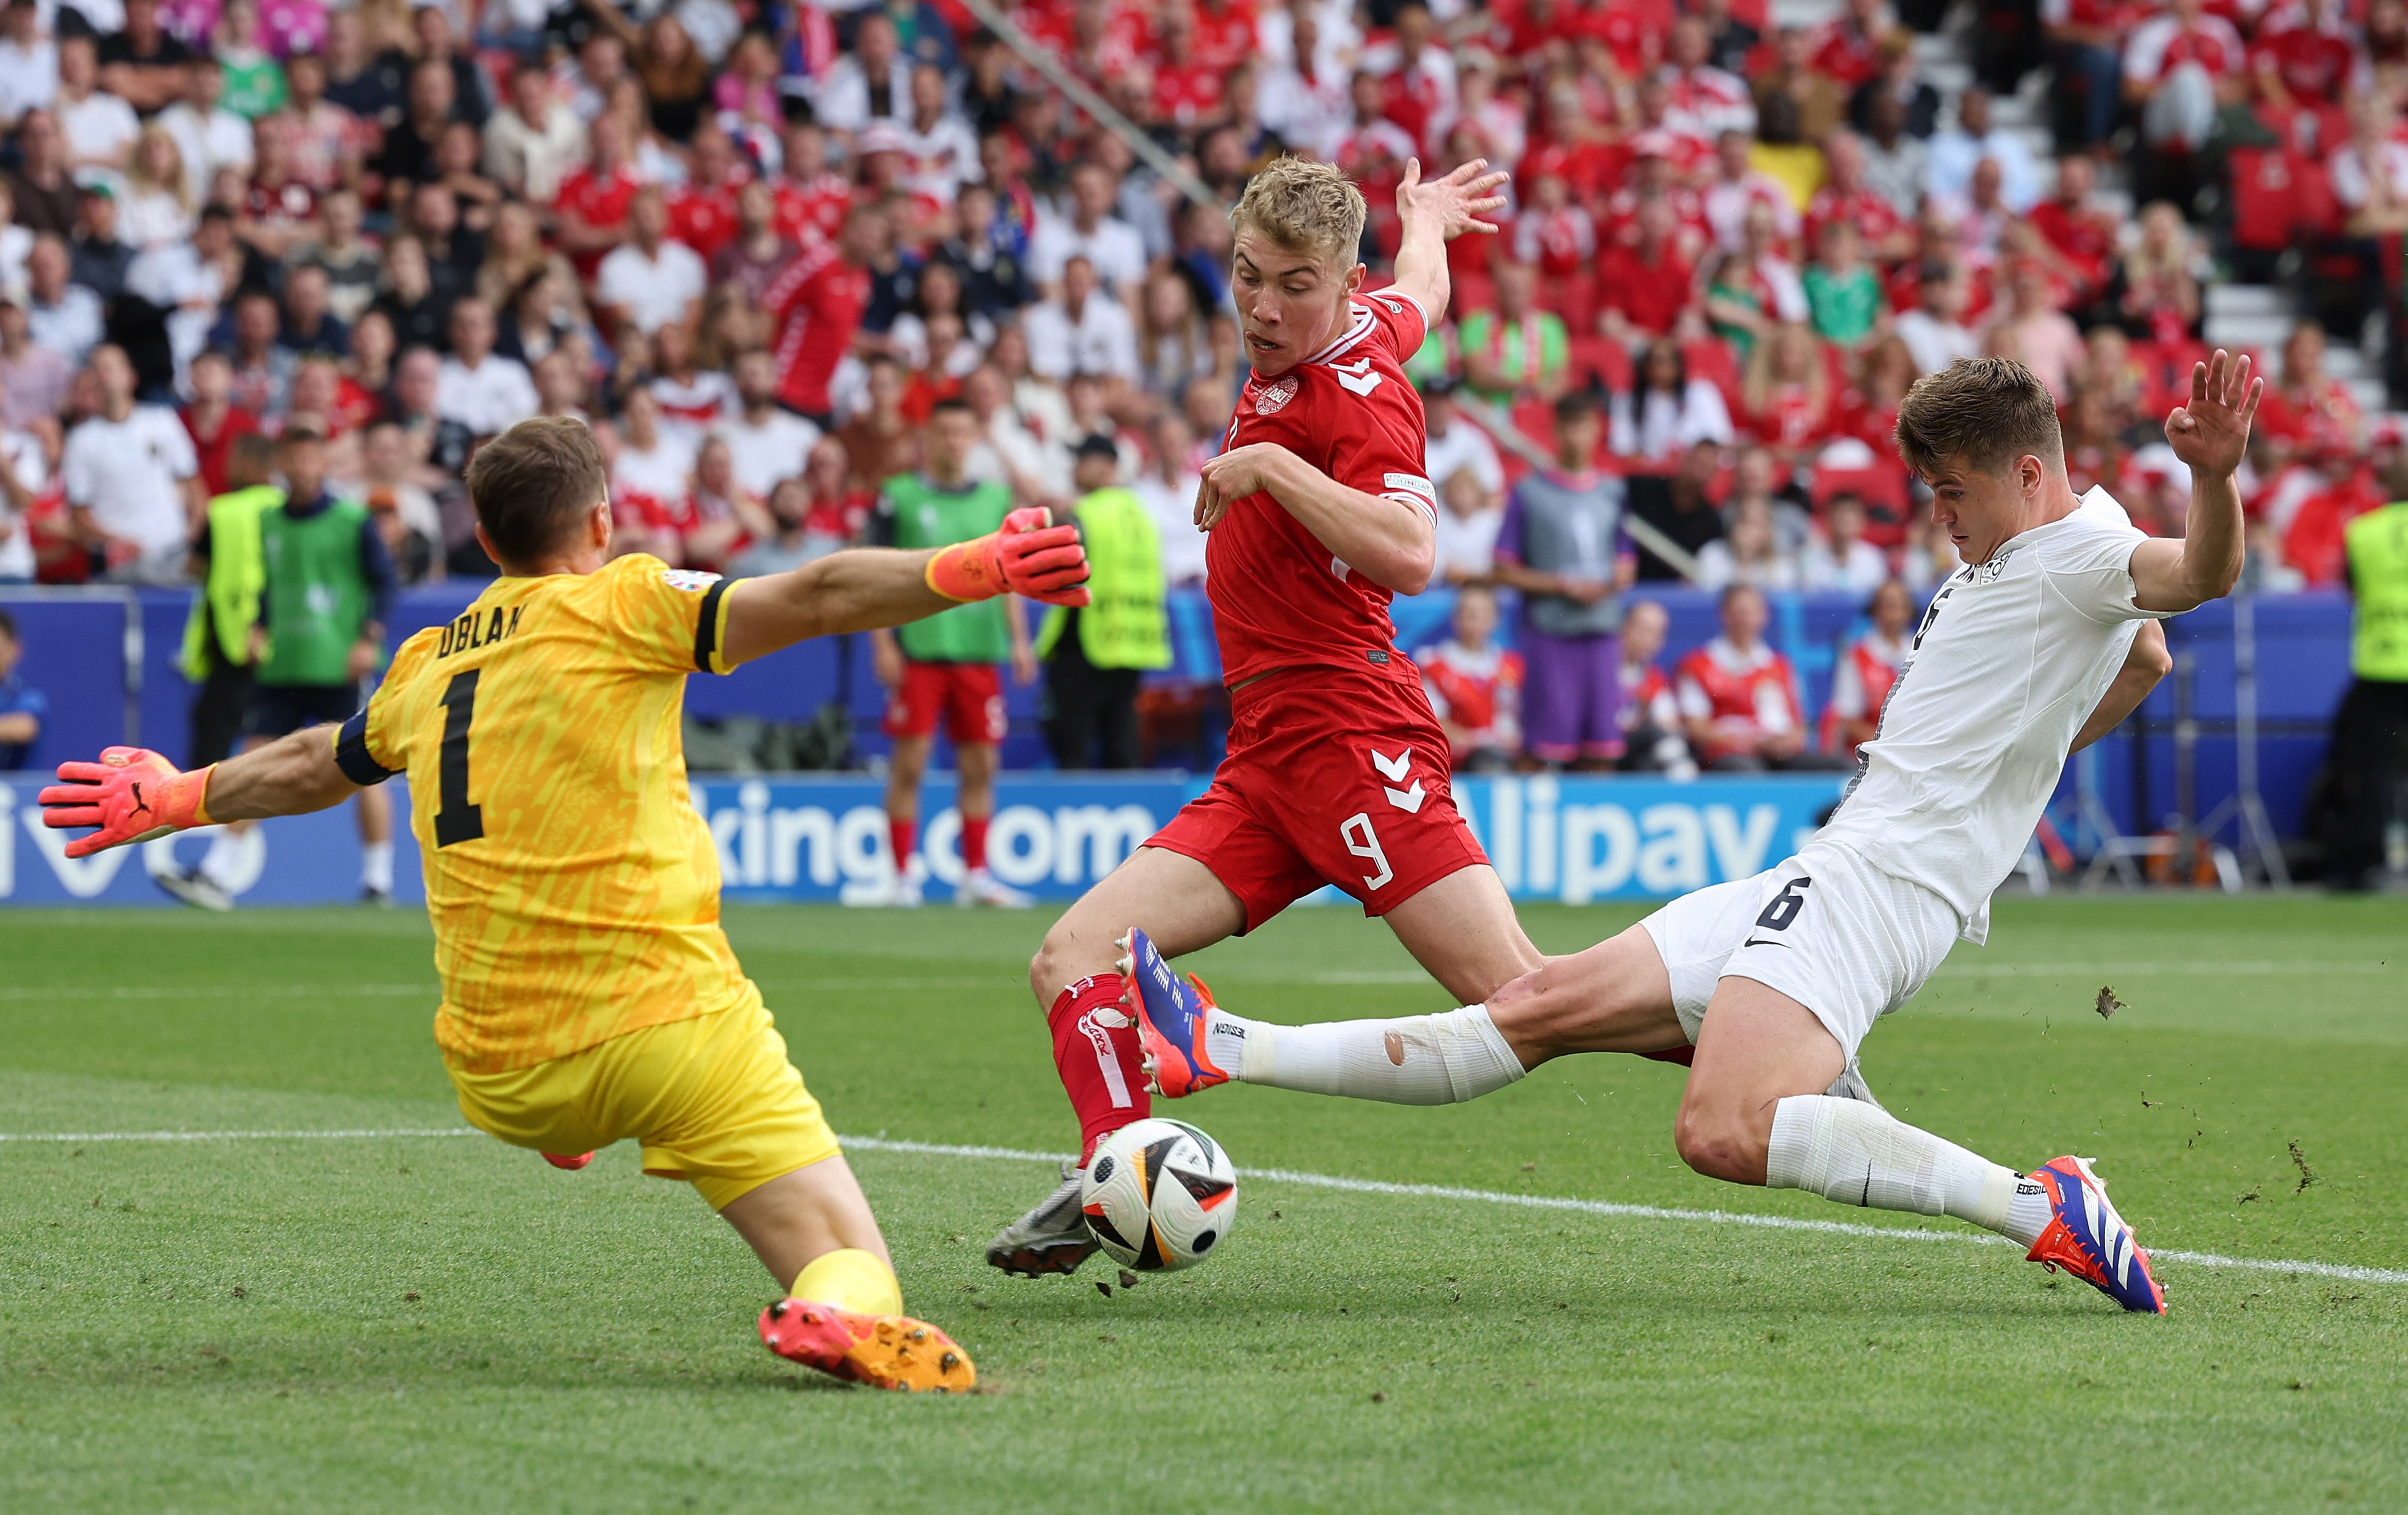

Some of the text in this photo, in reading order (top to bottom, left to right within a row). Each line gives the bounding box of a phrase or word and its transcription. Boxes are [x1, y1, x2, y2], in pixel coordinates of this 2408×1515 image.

[438, 602, 528, 658] OBLAK
[434, 669, 485, 848] 1
[1340, 812, 1394, 891] 9
[1755, 877, 1812, 931] 6
